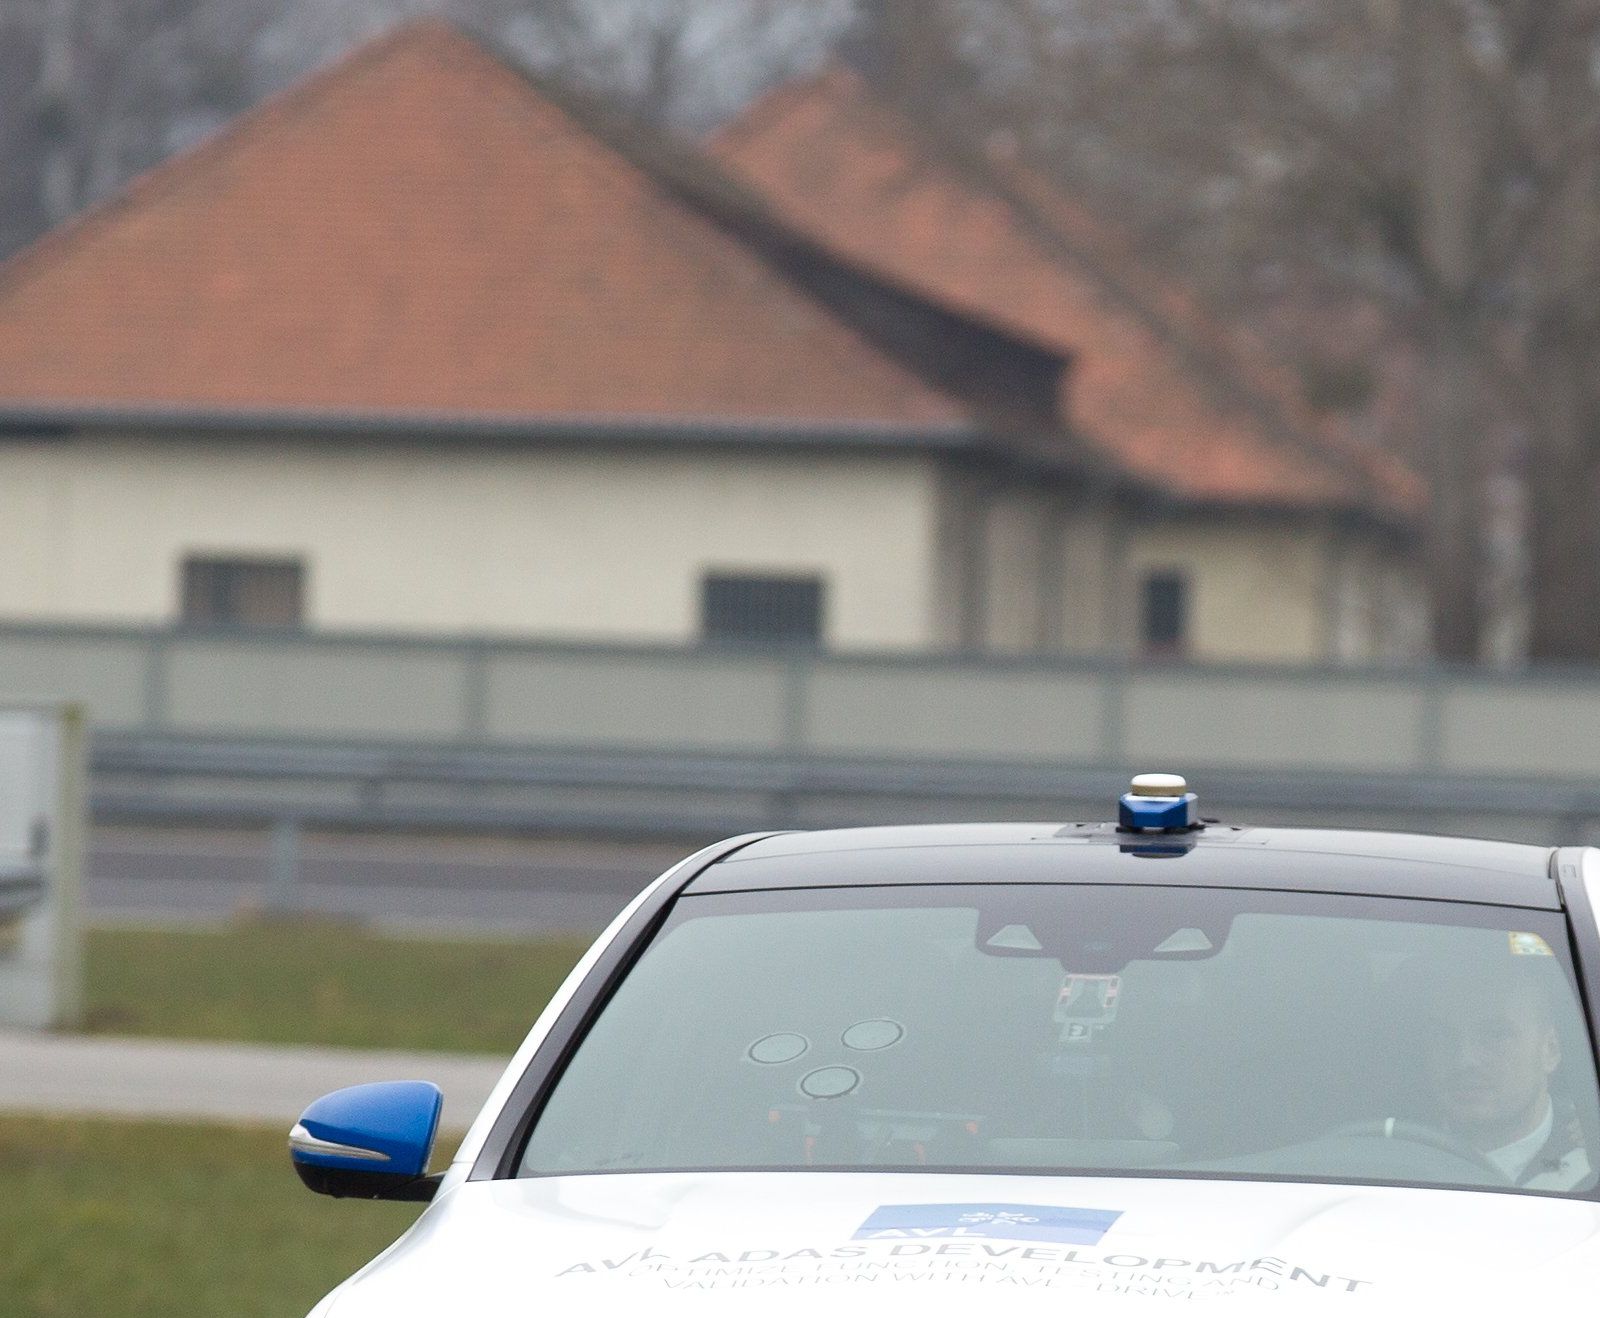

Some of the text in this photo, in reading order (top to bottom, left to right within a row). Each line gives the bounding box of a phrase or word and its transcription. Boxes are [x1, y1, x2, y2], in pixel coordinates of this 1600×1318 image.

[867, 1226, 987, 1239] AVL
[553, 1243, 1375, 1292] AVL ADAS DEVELOPMENT
